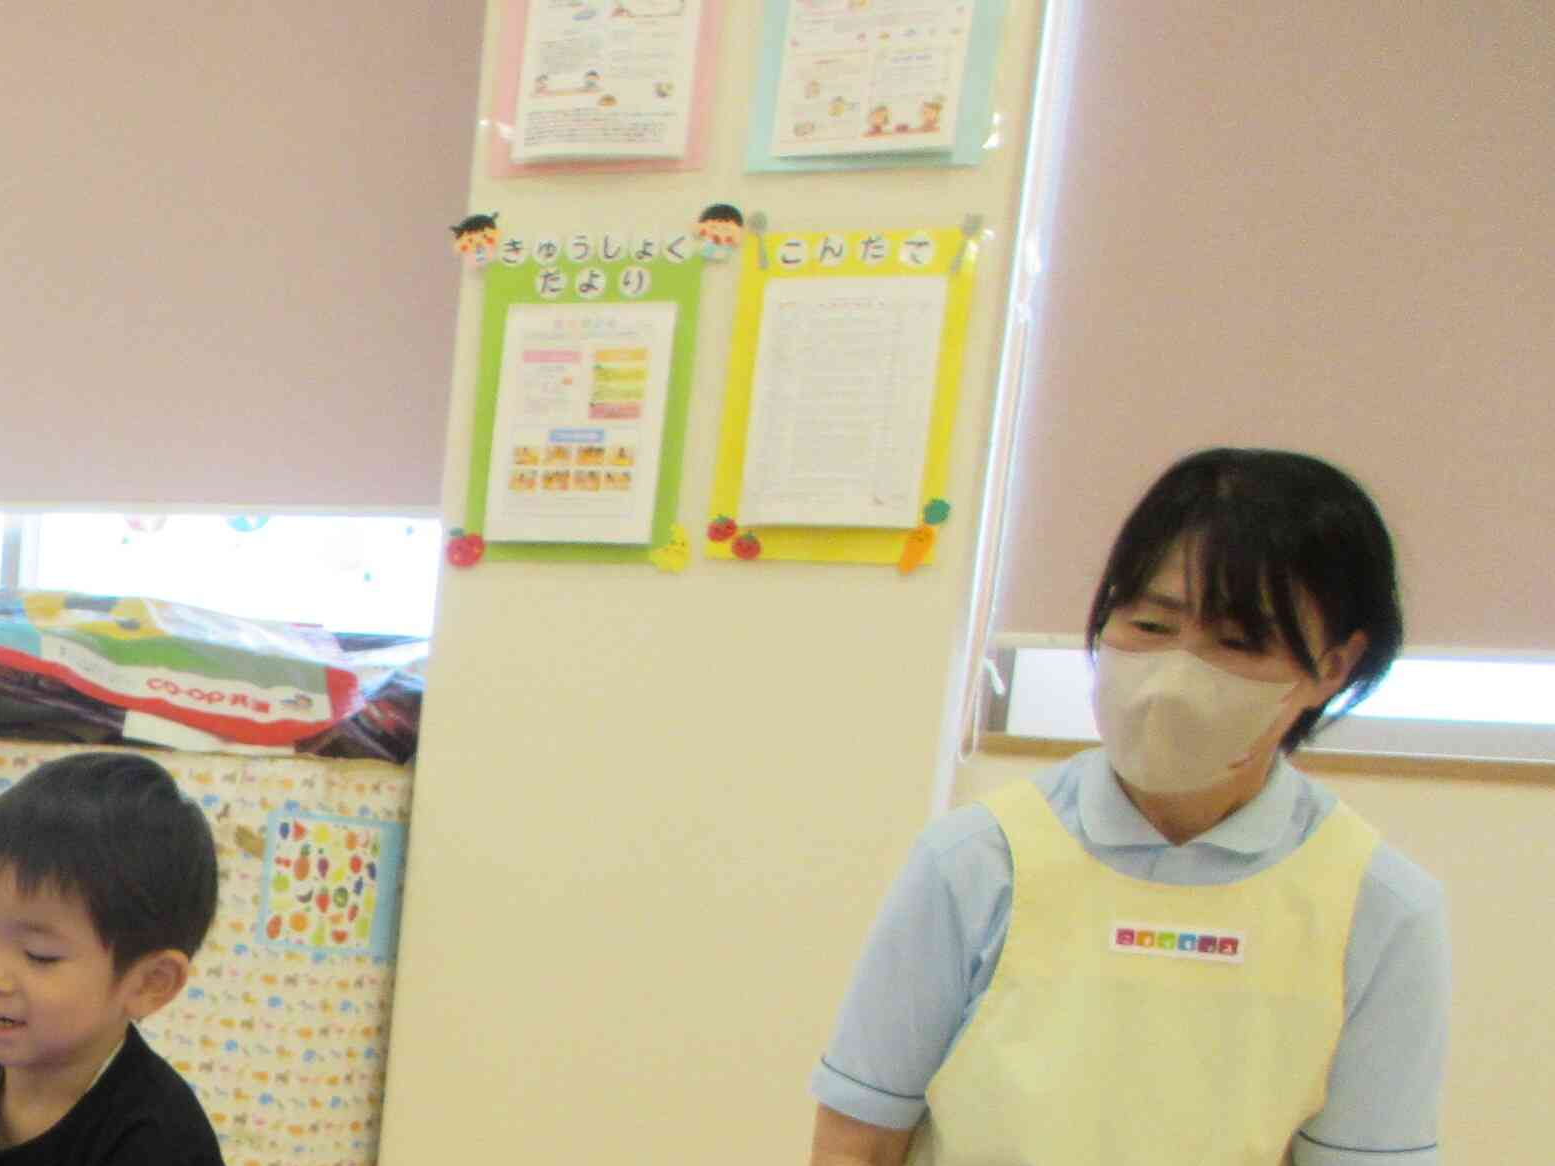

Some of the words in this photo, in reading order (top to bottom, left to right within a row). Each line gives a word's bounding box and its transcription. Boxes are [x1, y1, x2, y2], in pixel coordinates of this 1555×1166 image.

[501, 233, 687, 264] きゅうしょく
[780, 234, 931, 265] こんだて
